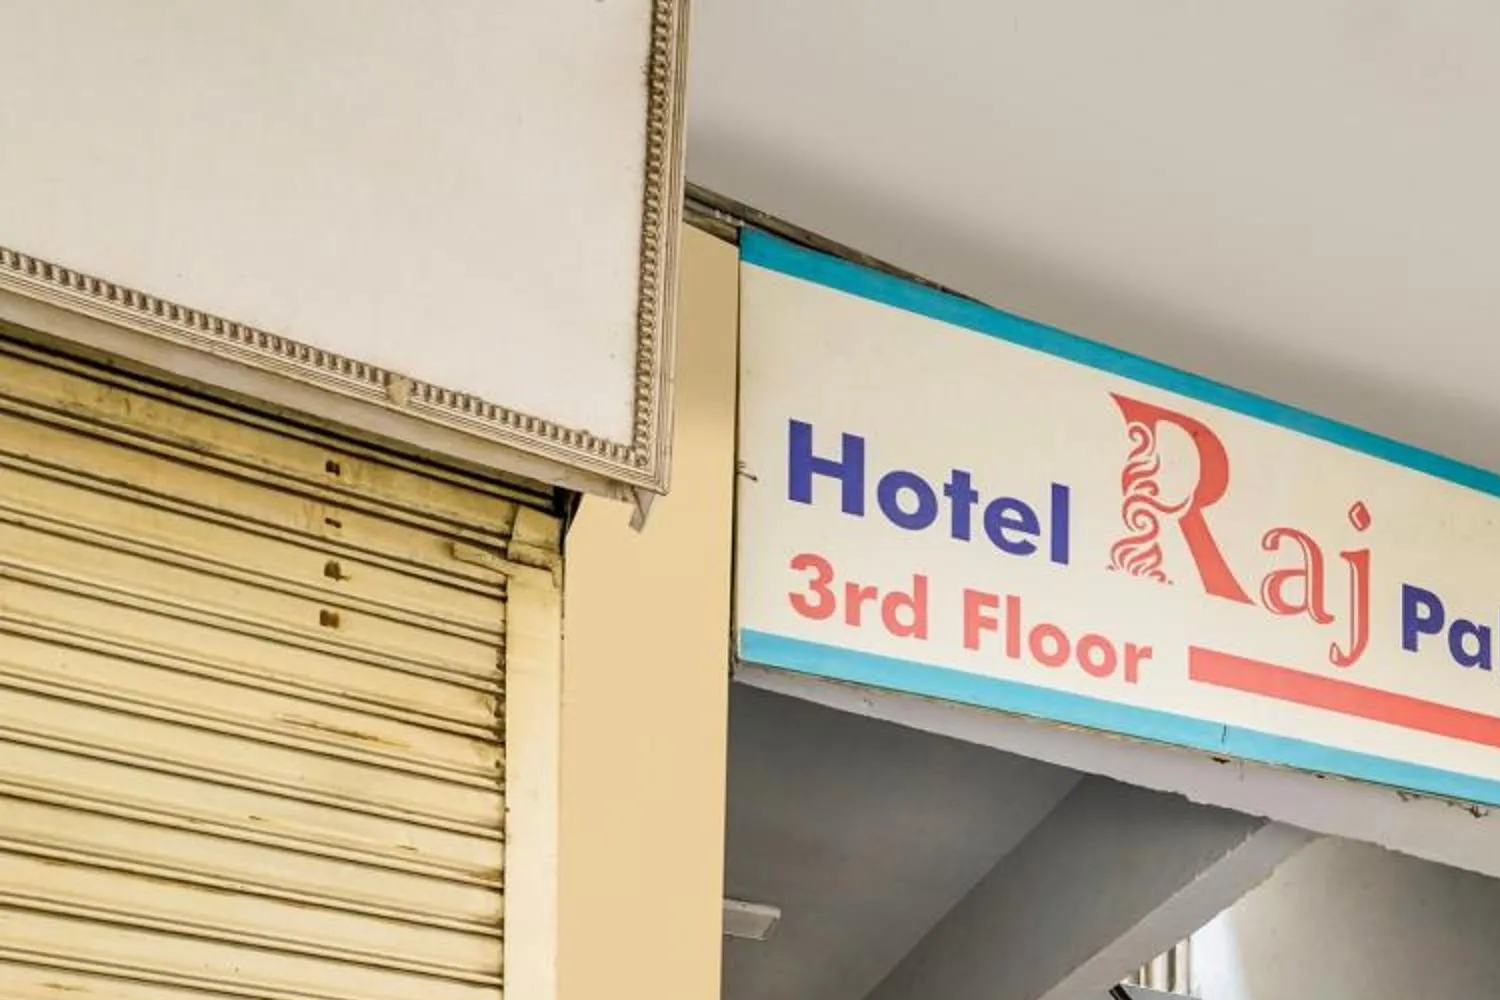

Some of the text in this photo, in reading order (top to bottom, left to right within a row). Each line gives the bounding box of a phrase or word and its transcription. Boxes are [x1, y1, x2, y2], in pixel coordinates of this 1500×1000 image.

[787, 419, 1070, 565] Hotel
[1106, 391, 1372, 668] Raj
[787, 552, 1153, 684] 3rd Floor
